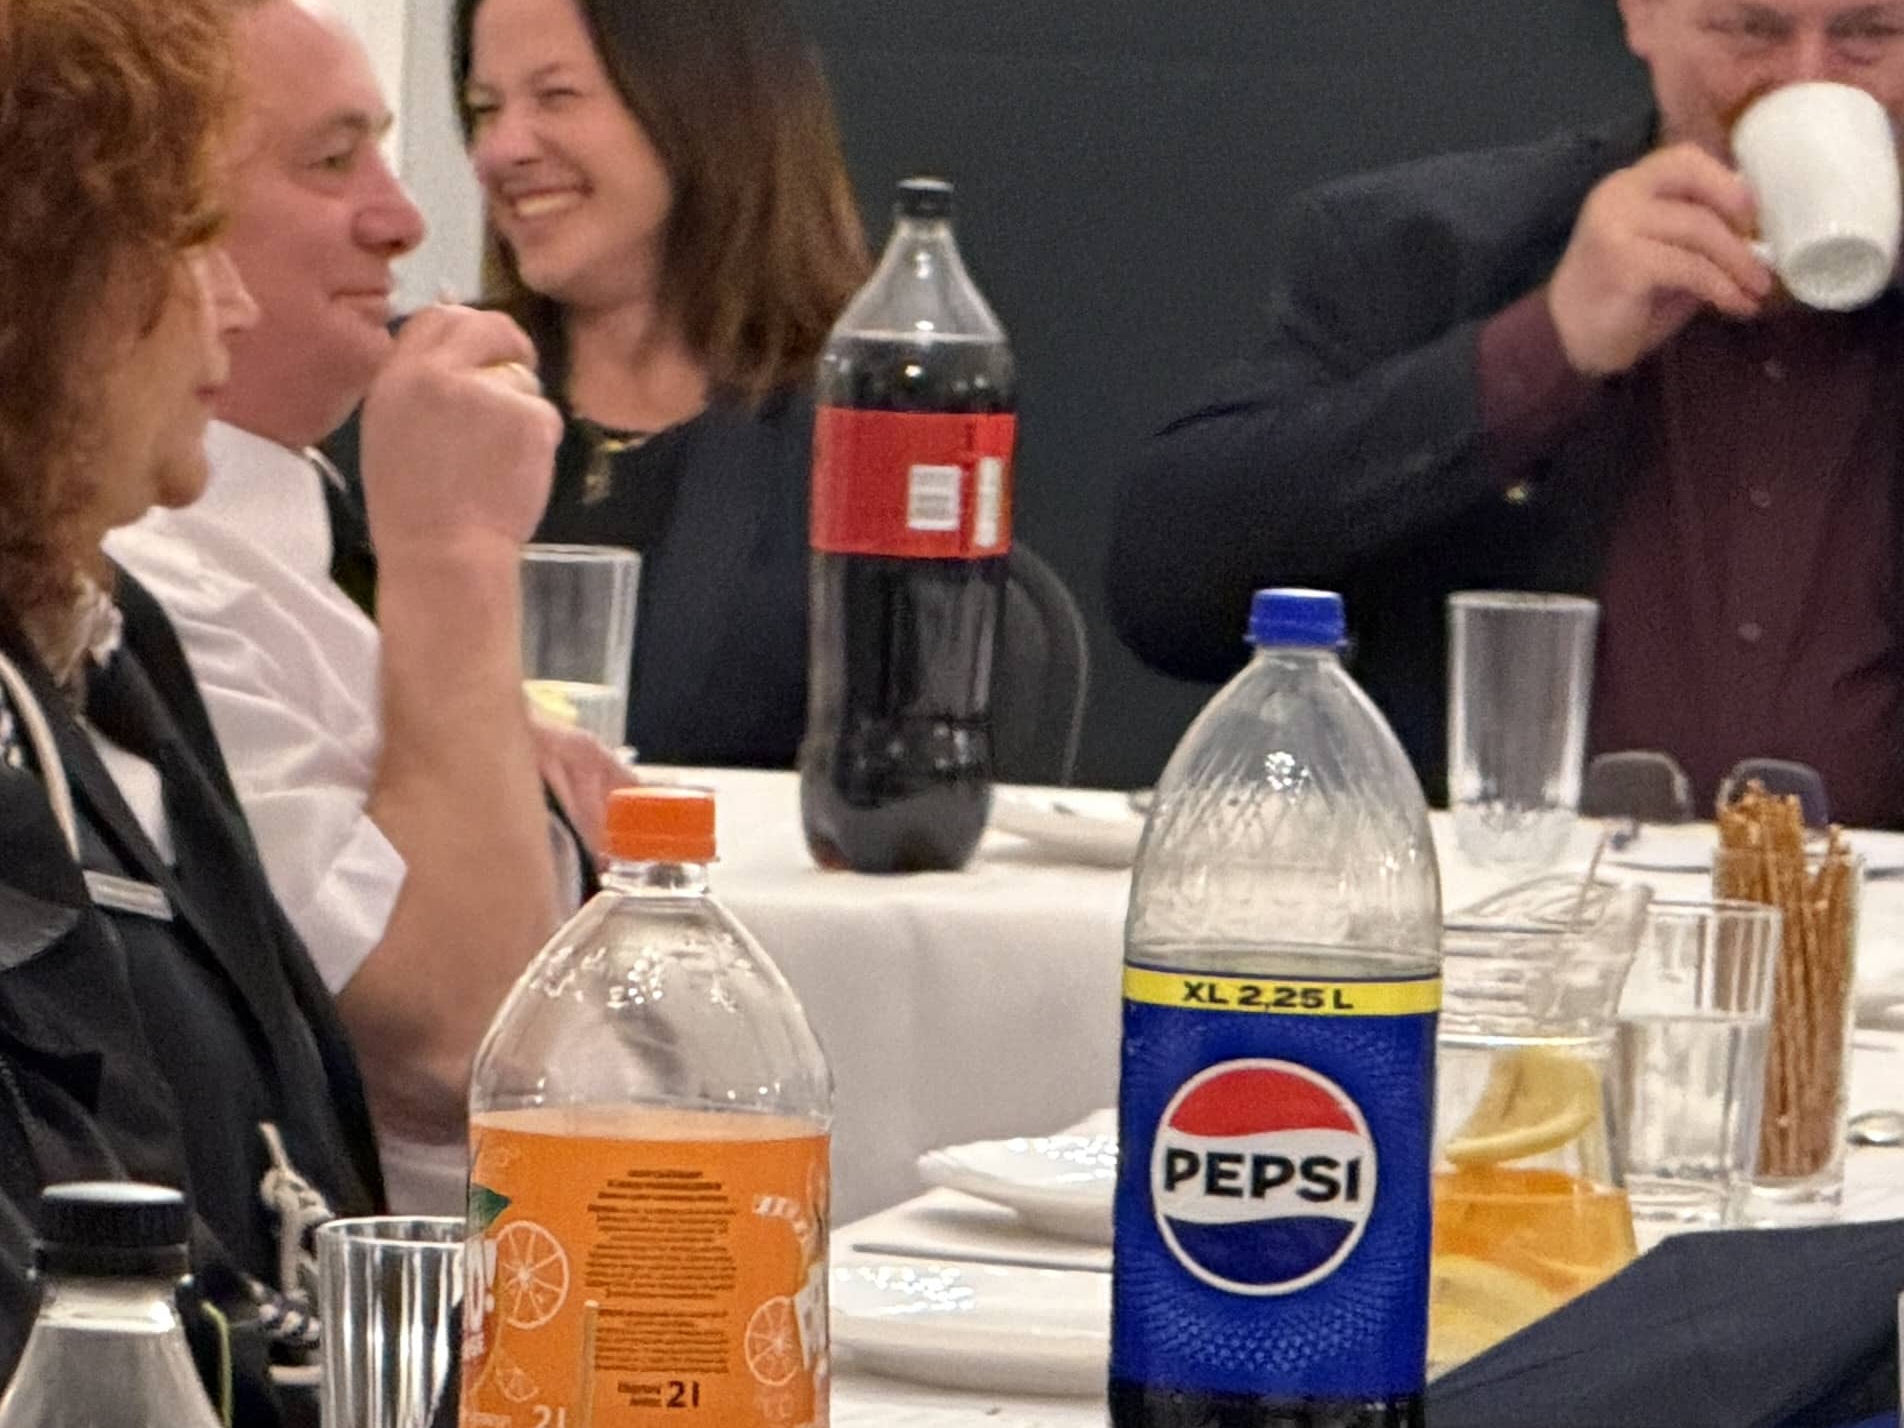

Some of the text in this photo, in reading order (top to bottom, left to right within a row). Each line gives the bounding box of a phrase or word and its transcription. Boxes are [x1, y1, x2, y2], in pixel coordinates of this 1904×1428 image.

[1181, 980, 1354, 1012] XL 2,25 L
[1163, 1146, 1361, 1204] PEPSI
